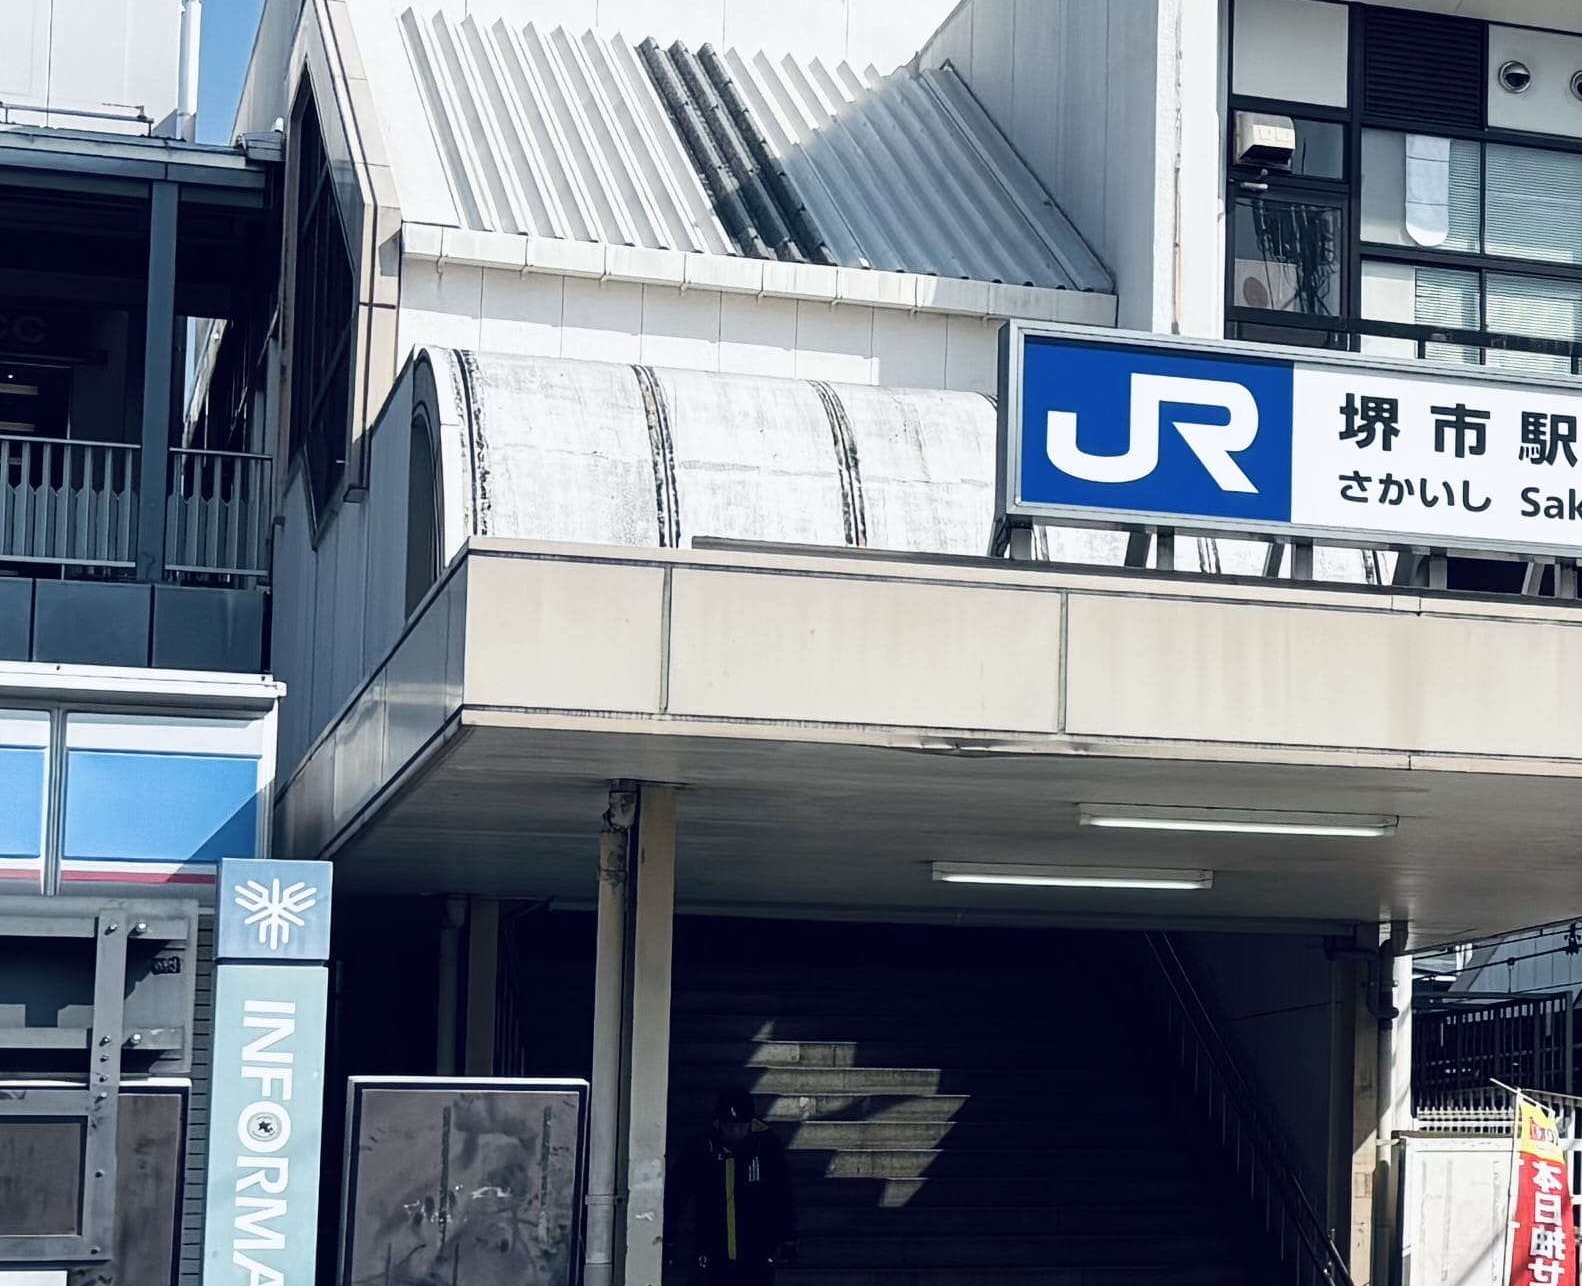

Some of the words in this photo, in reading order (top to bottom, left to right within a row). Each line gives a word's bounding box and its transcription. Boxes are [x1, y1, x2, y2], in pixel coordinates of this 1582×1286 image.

[1046, 372, 1259, 495] JR
[1339, 392, 1579, 468] 堺市駅
[1339, 470, 1493, 514] さかいし
